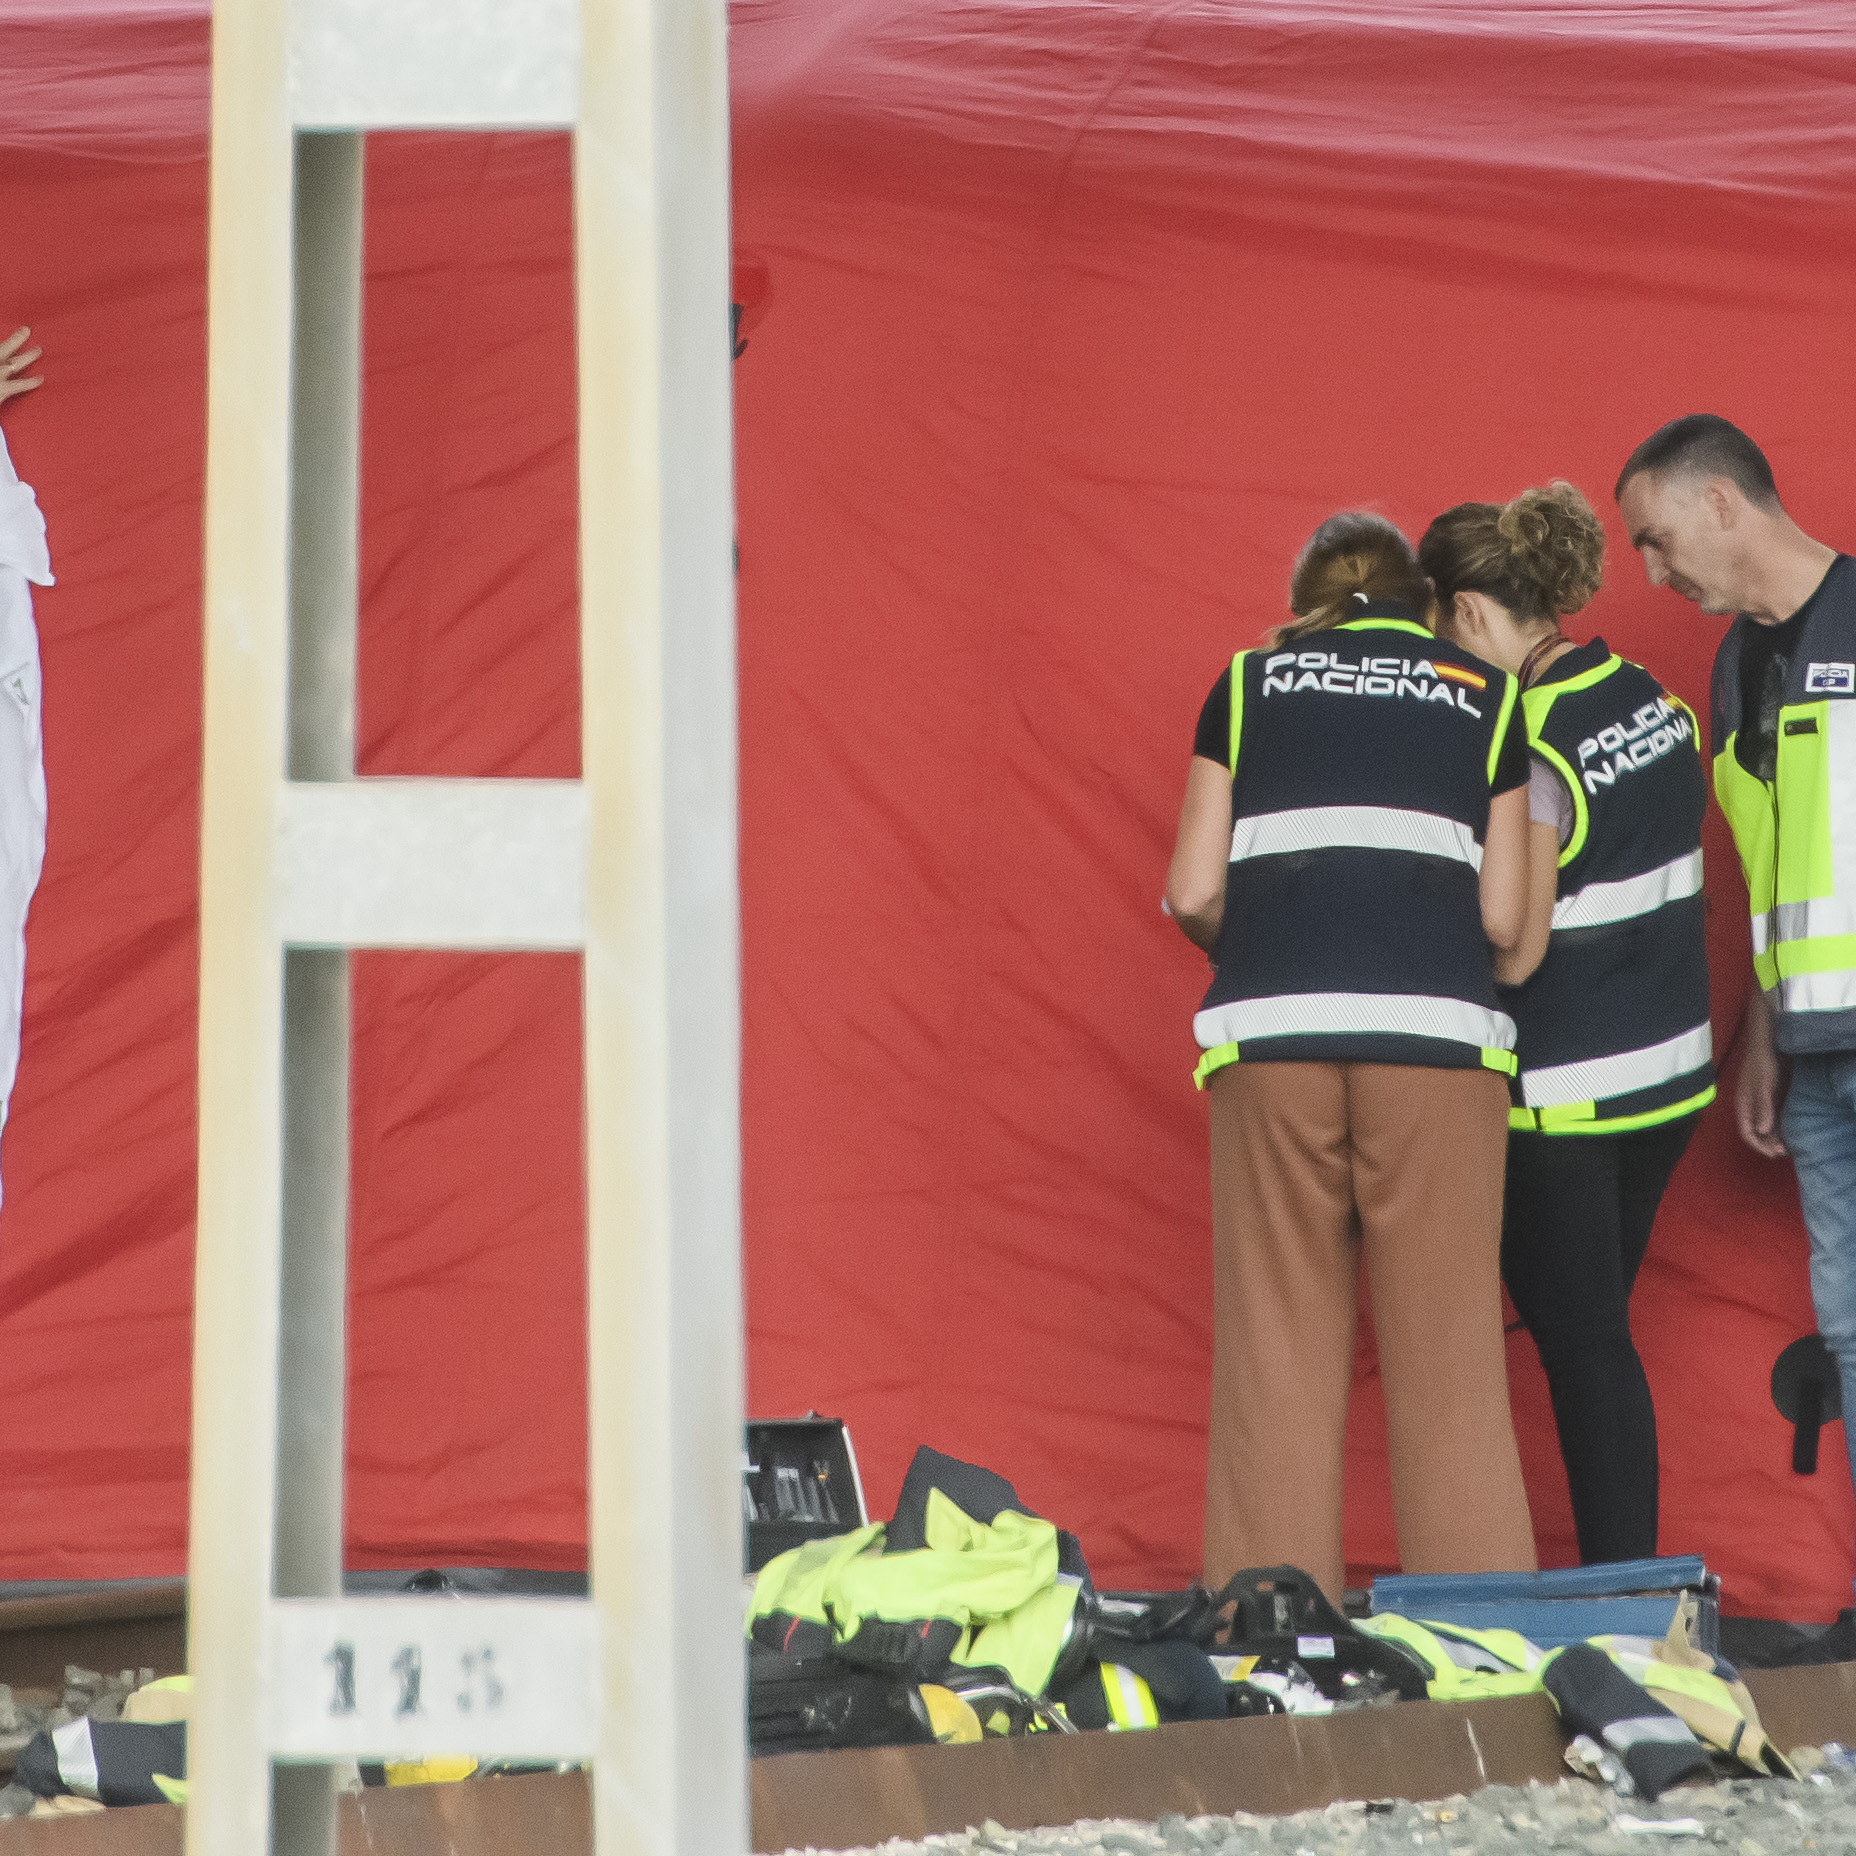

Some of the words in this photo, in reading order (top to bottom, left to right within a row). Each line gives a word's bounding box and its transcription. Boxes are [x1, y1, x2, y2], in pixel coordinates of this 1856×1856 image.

[1262, 670, 1482, 719] NACIONAL
[1265, 652, 1439, 681] POLICIA
[1577, 696, 1676, 769] POLICIA
[1583, 715, 1693, 796] NACIONA
